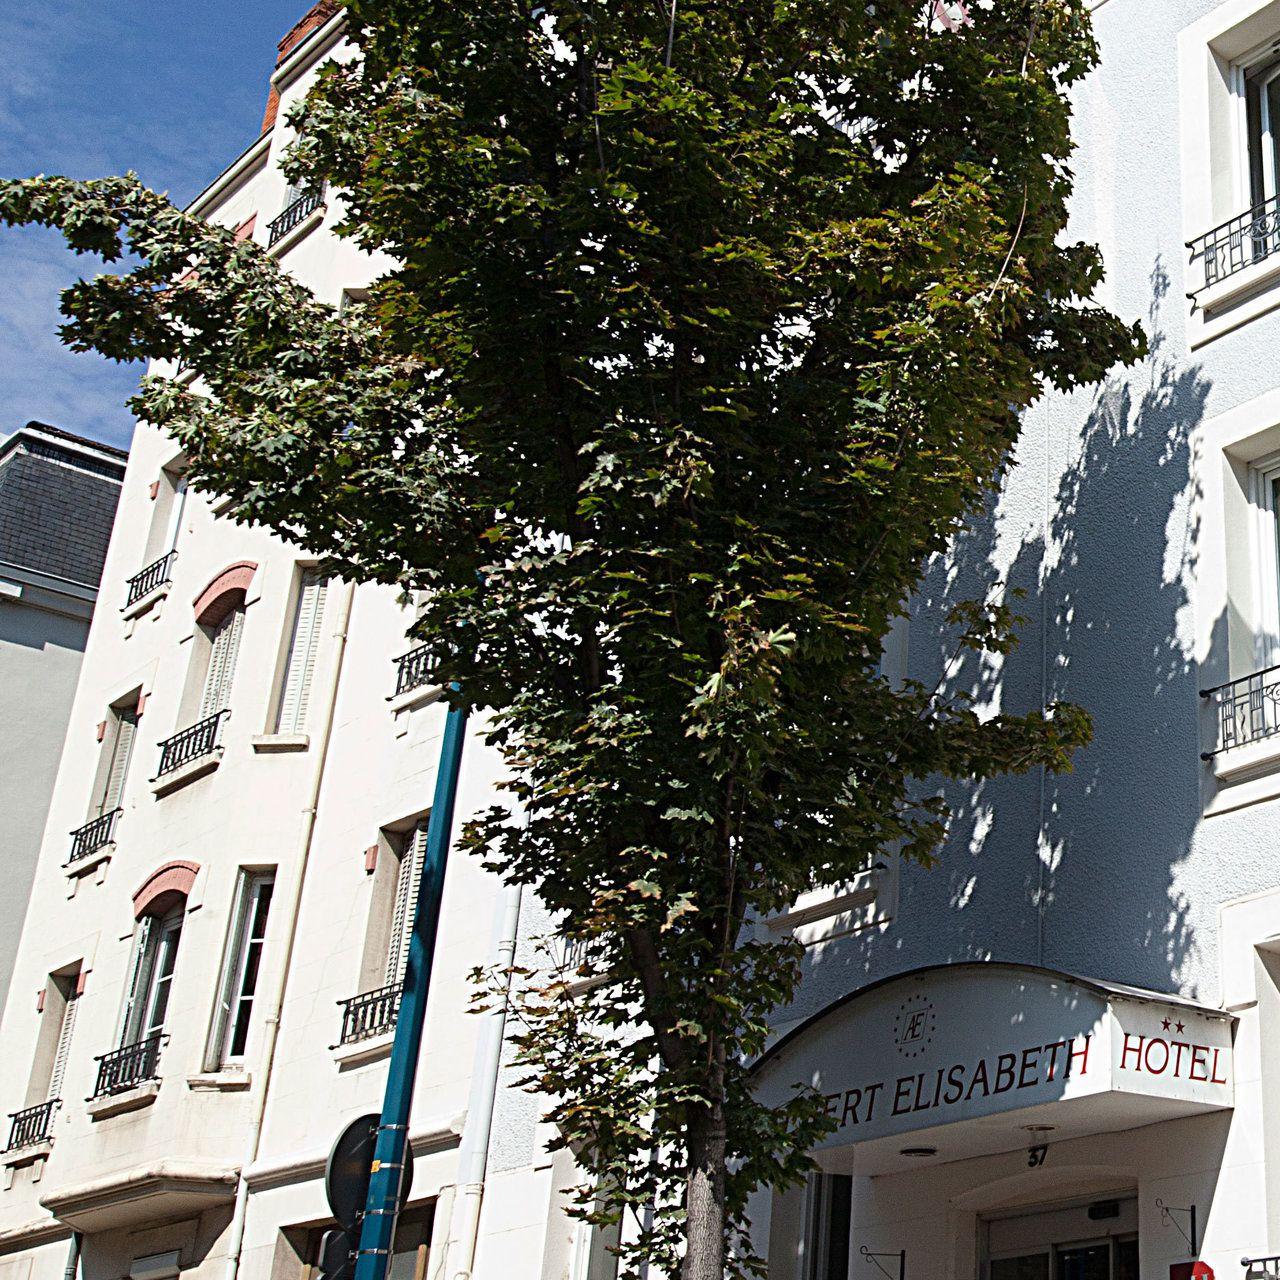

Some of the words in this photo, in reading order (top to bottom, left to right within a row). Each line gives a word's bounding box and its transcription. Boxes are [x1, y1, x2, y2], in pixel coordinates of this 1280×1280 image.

[890, 1035, 1091, 1117] ELISABETH
[1120, 1032, 1228, 1085] HOTEL
[1027, 1143, 1049, 1168] 37
